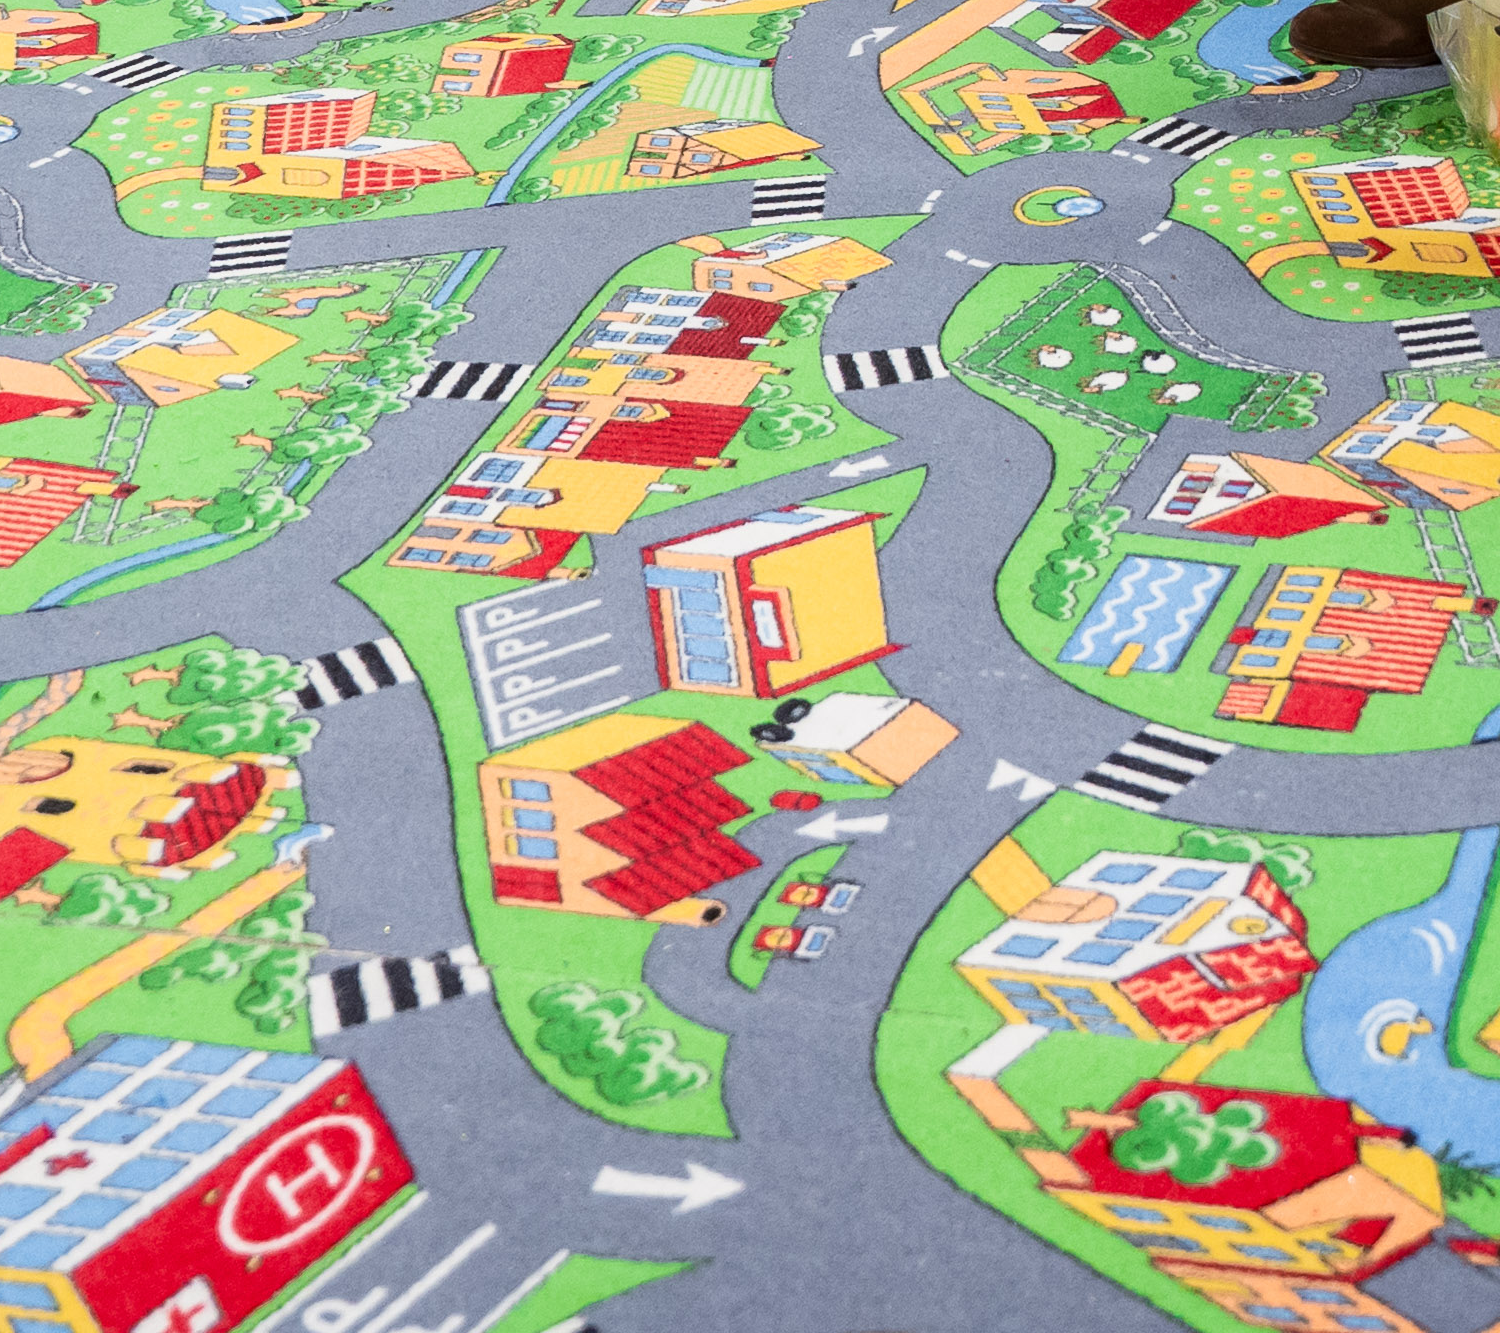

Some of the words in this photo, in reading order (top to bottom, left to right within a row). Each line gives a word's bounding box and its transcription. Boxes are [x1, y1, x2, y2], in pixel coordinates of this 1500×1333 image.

[485, 607, 540, 629] P
[495, 638, 549, 663] P
[503, 674, 557, 699] P
[508, 706, 565, 731] P
[267, 1141, 342, 1218] H
